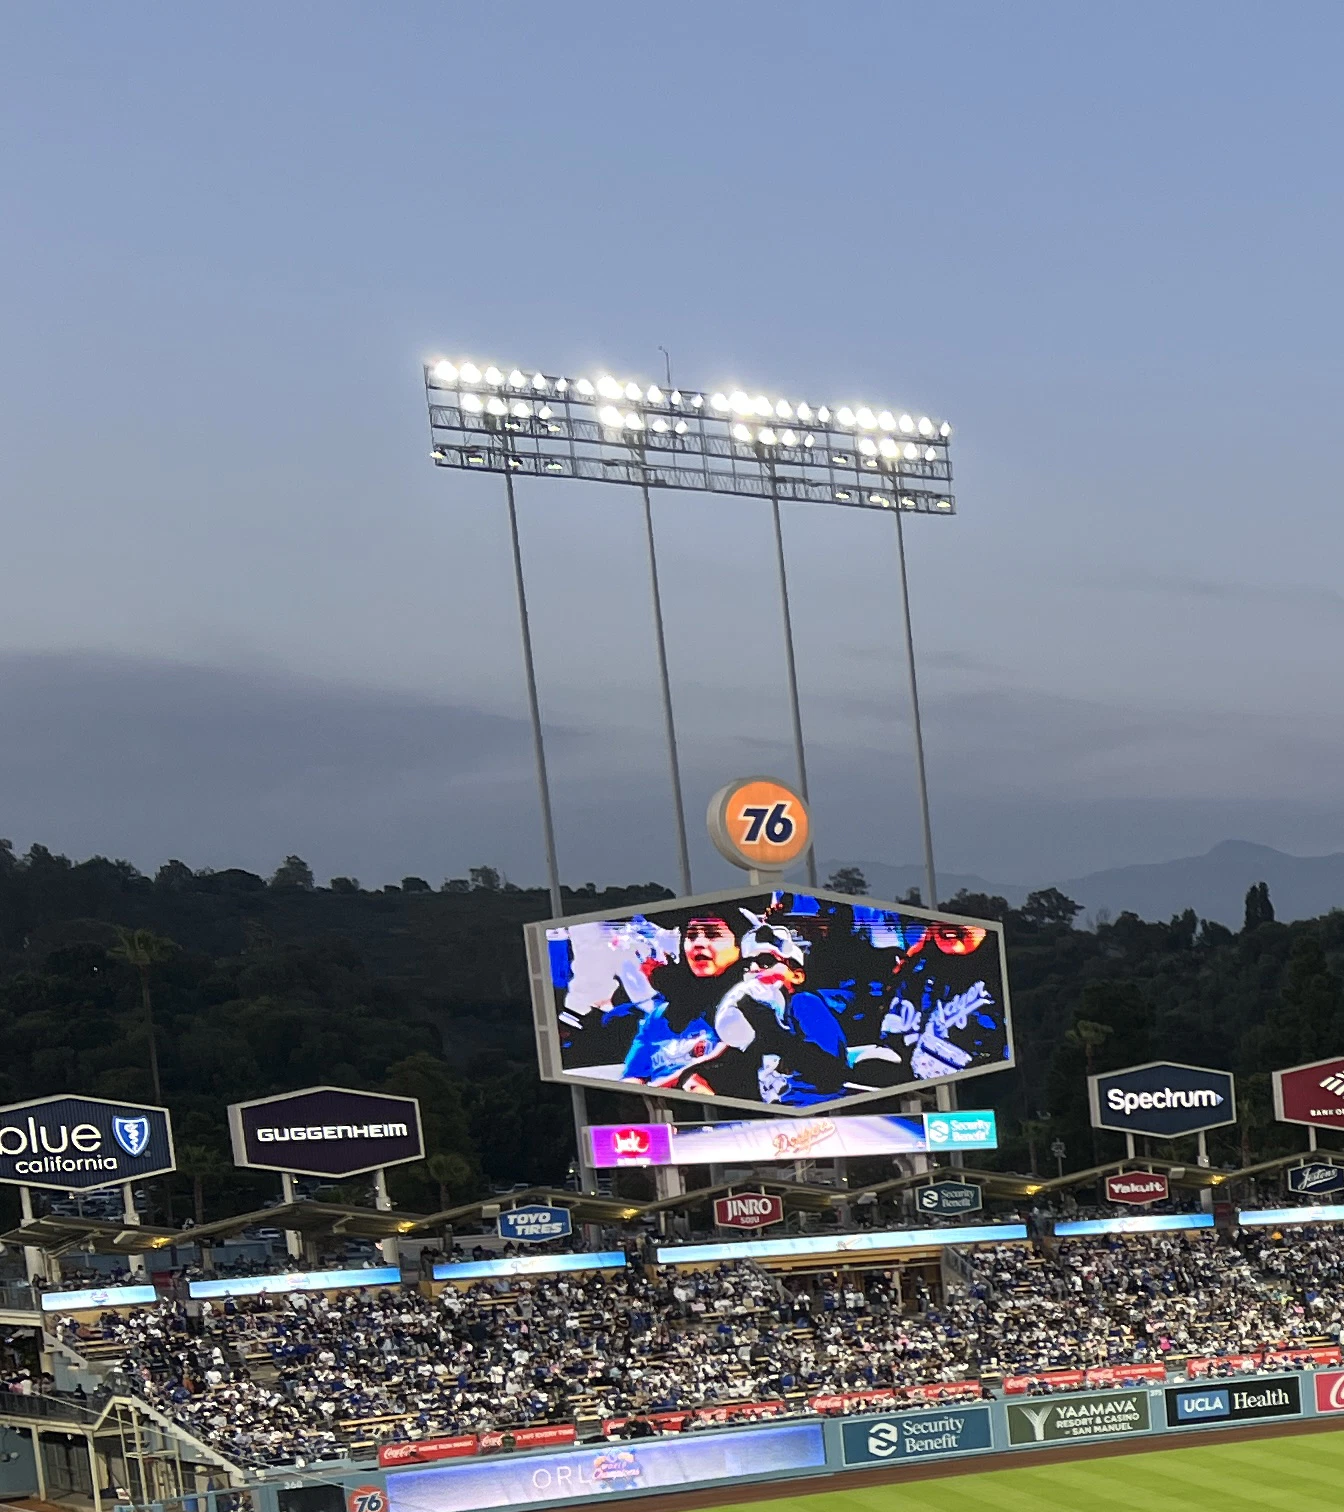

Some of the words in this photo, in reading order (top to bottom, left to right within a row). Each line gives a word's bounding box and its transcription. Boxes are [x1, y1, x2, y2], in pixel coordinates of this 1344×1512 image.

[738, 801, 797, 847] 76
[1107, 1086, 1218, 1114] Spectrum
[1310, 1109, 1334, 1117] BANK
[256, 1123, 408, 1143] GUGGENHEIM
[951, 1119, 992, 1134] Security
[952, 1131, 986, 1142] Benefit
[15, 1154, 118, 1174] california
[940, 1188, 975, 1200] Security
[1110, 1182, 1165, 1195] Yakult
[726, 1198, 772, 1221] JINRO
[942, 1198, 971, 1208] Benefit
[507, 1212, 551, 1226] TOYO
[515, 1222, 562, 1236] TIRES
[1183, 1396, 1224, 1413] UCLA
[1233, 1388, 1290, 1411] Health
[902, 1415, 965, 1437] Security
[1056, 1418, 1094, 1429] RESORT
[1105, 1411, 1140, 1424] CASINO
[1072, 1426, 1092, 1436] SAN
[1094, 1421, 1134, 1435] MANUEL
[904, 1432, 959, 1454] Benefit
